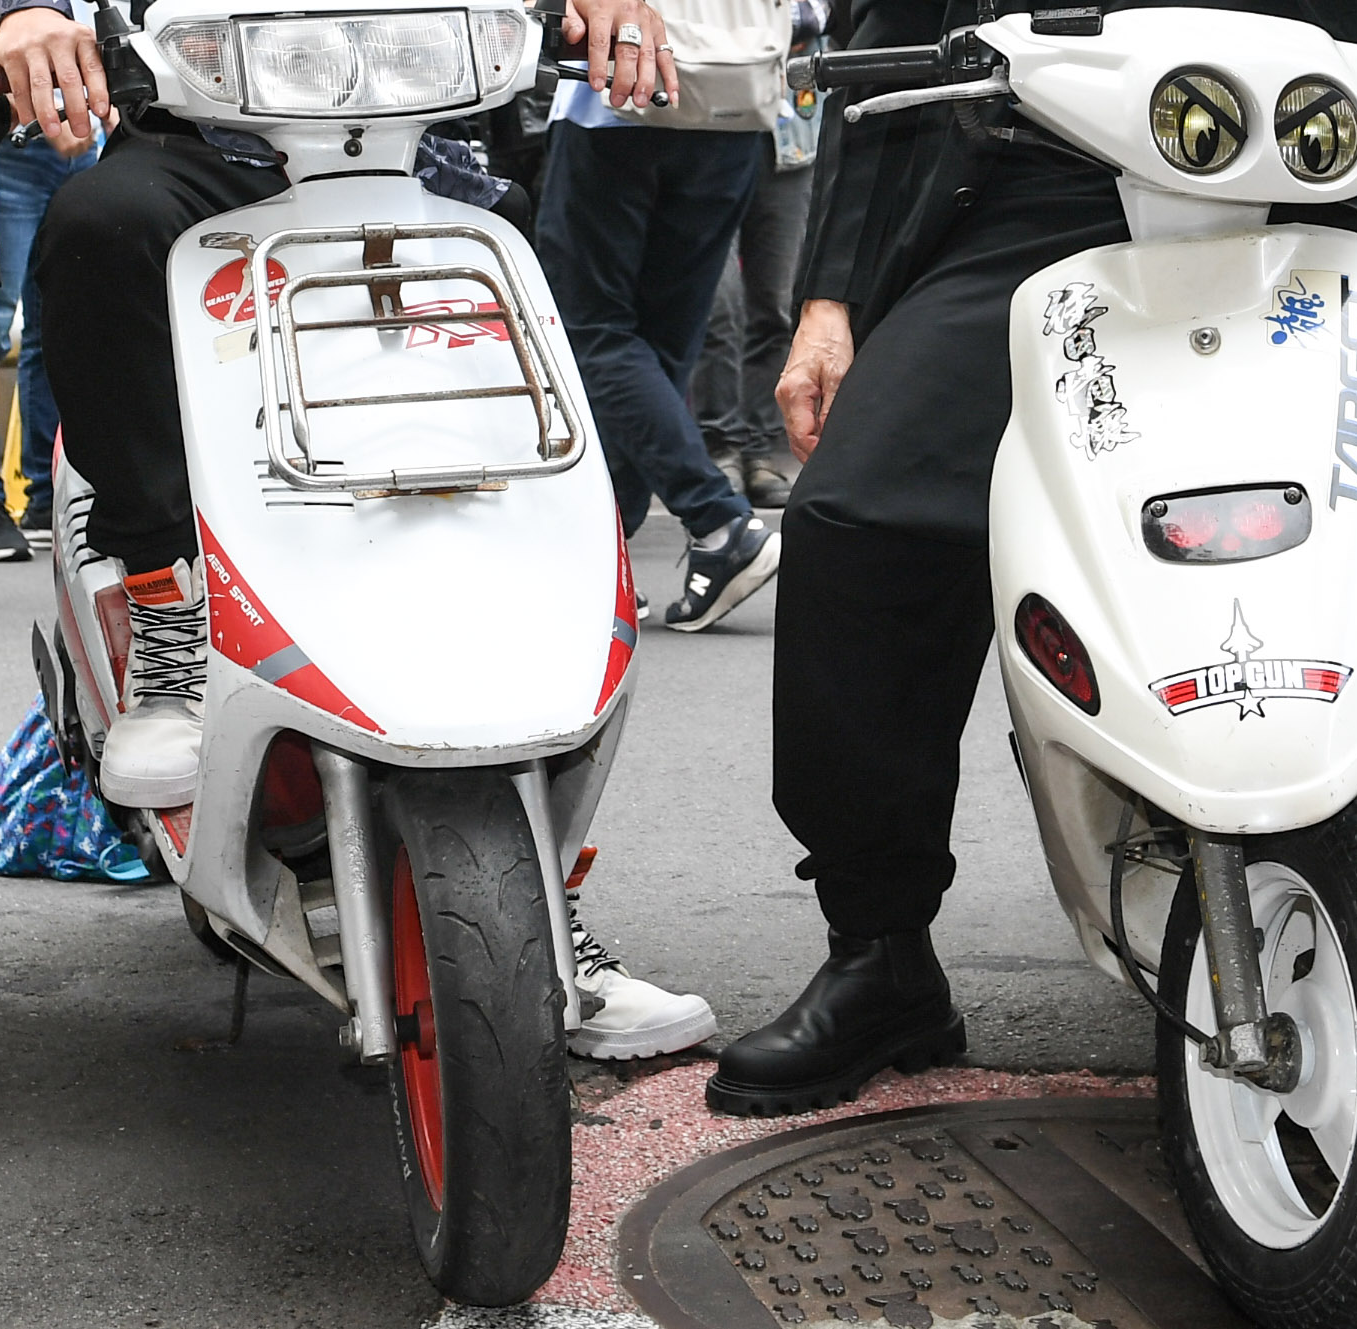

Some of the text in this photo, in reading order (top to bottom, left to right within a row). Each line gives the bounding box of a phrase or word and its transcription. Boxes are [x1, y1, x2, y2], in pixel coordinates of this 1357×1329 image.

[205, 552, 265, 627] AERO SPORT
[1195, 660, 1305, 698] TOP GUN
